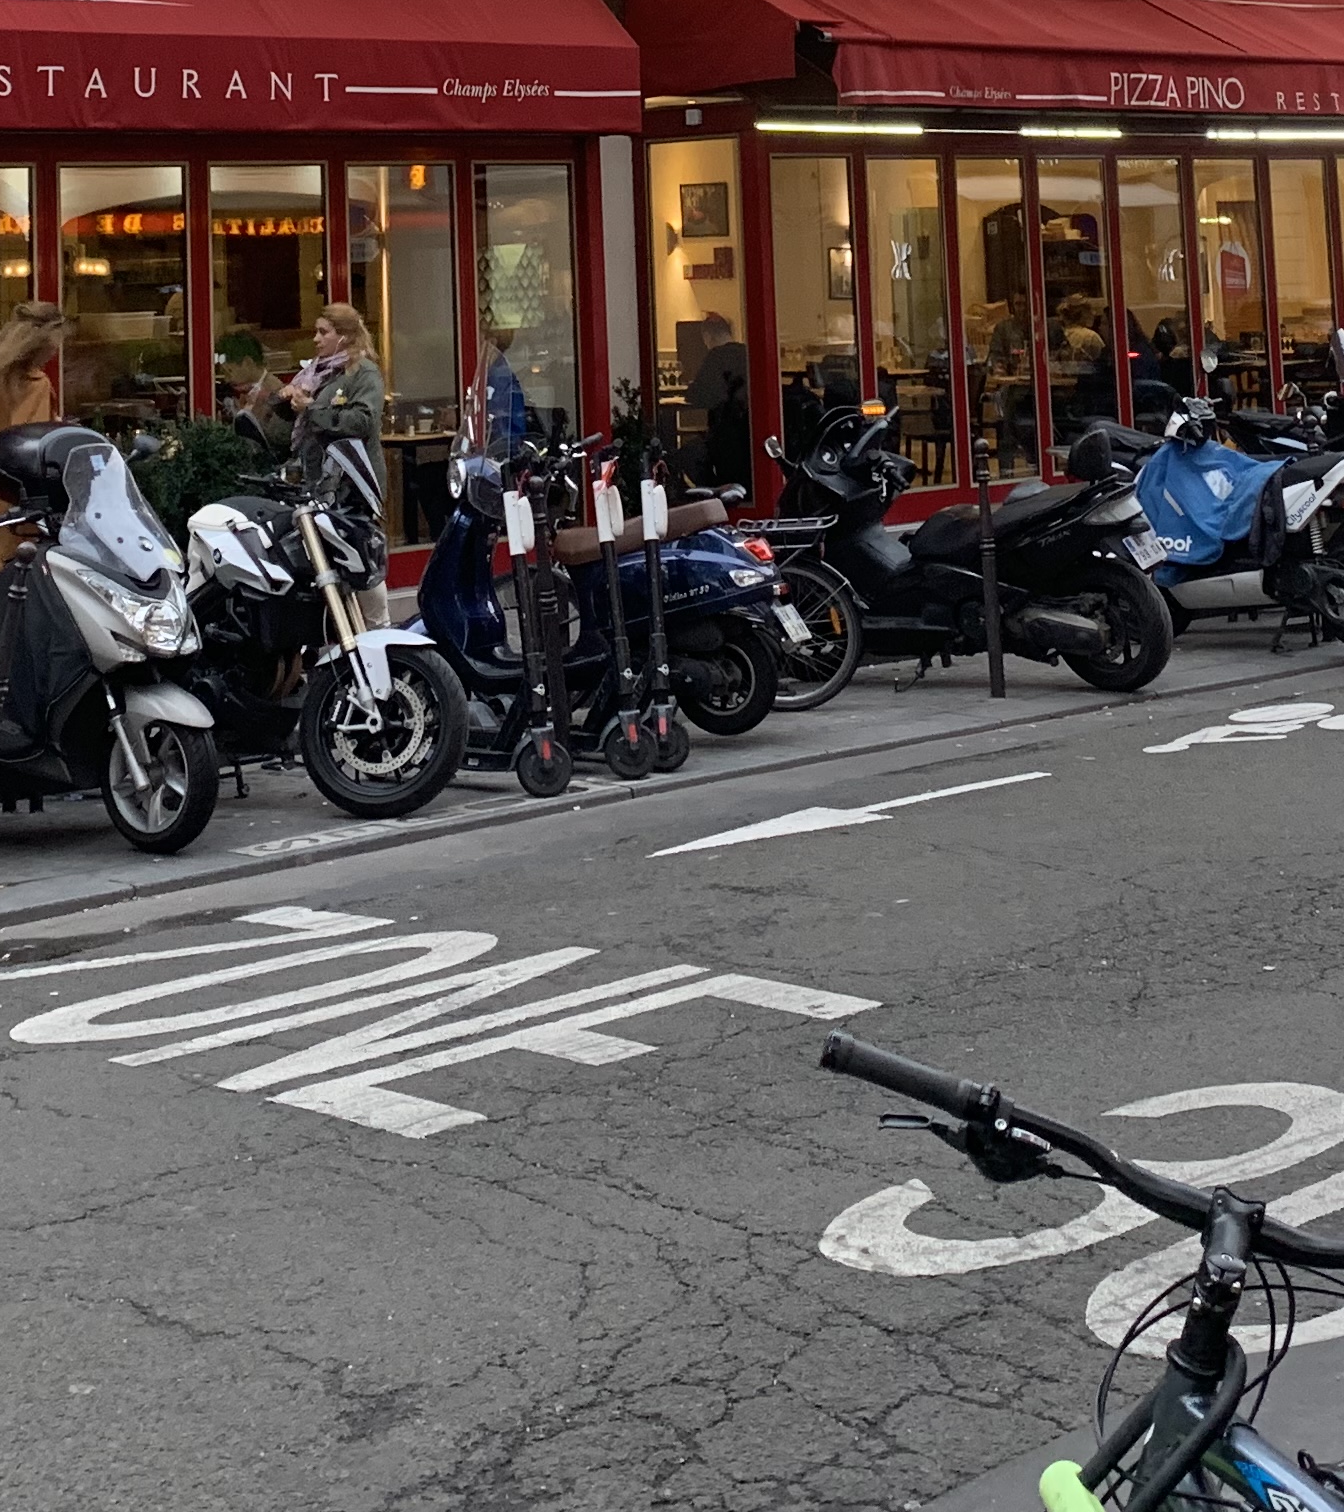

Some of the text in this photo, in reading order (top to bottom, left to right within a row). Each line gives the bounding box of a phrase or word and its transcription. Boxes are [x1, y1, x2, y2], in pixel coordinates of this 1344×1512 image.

[441, 76, 551, 104] Champs Elysées
[1109, 71, 1182, 107] PIZZA
[1186, 75, 1246, 110] PINO
[1285, 492, 1317, 527] Cityscoot
